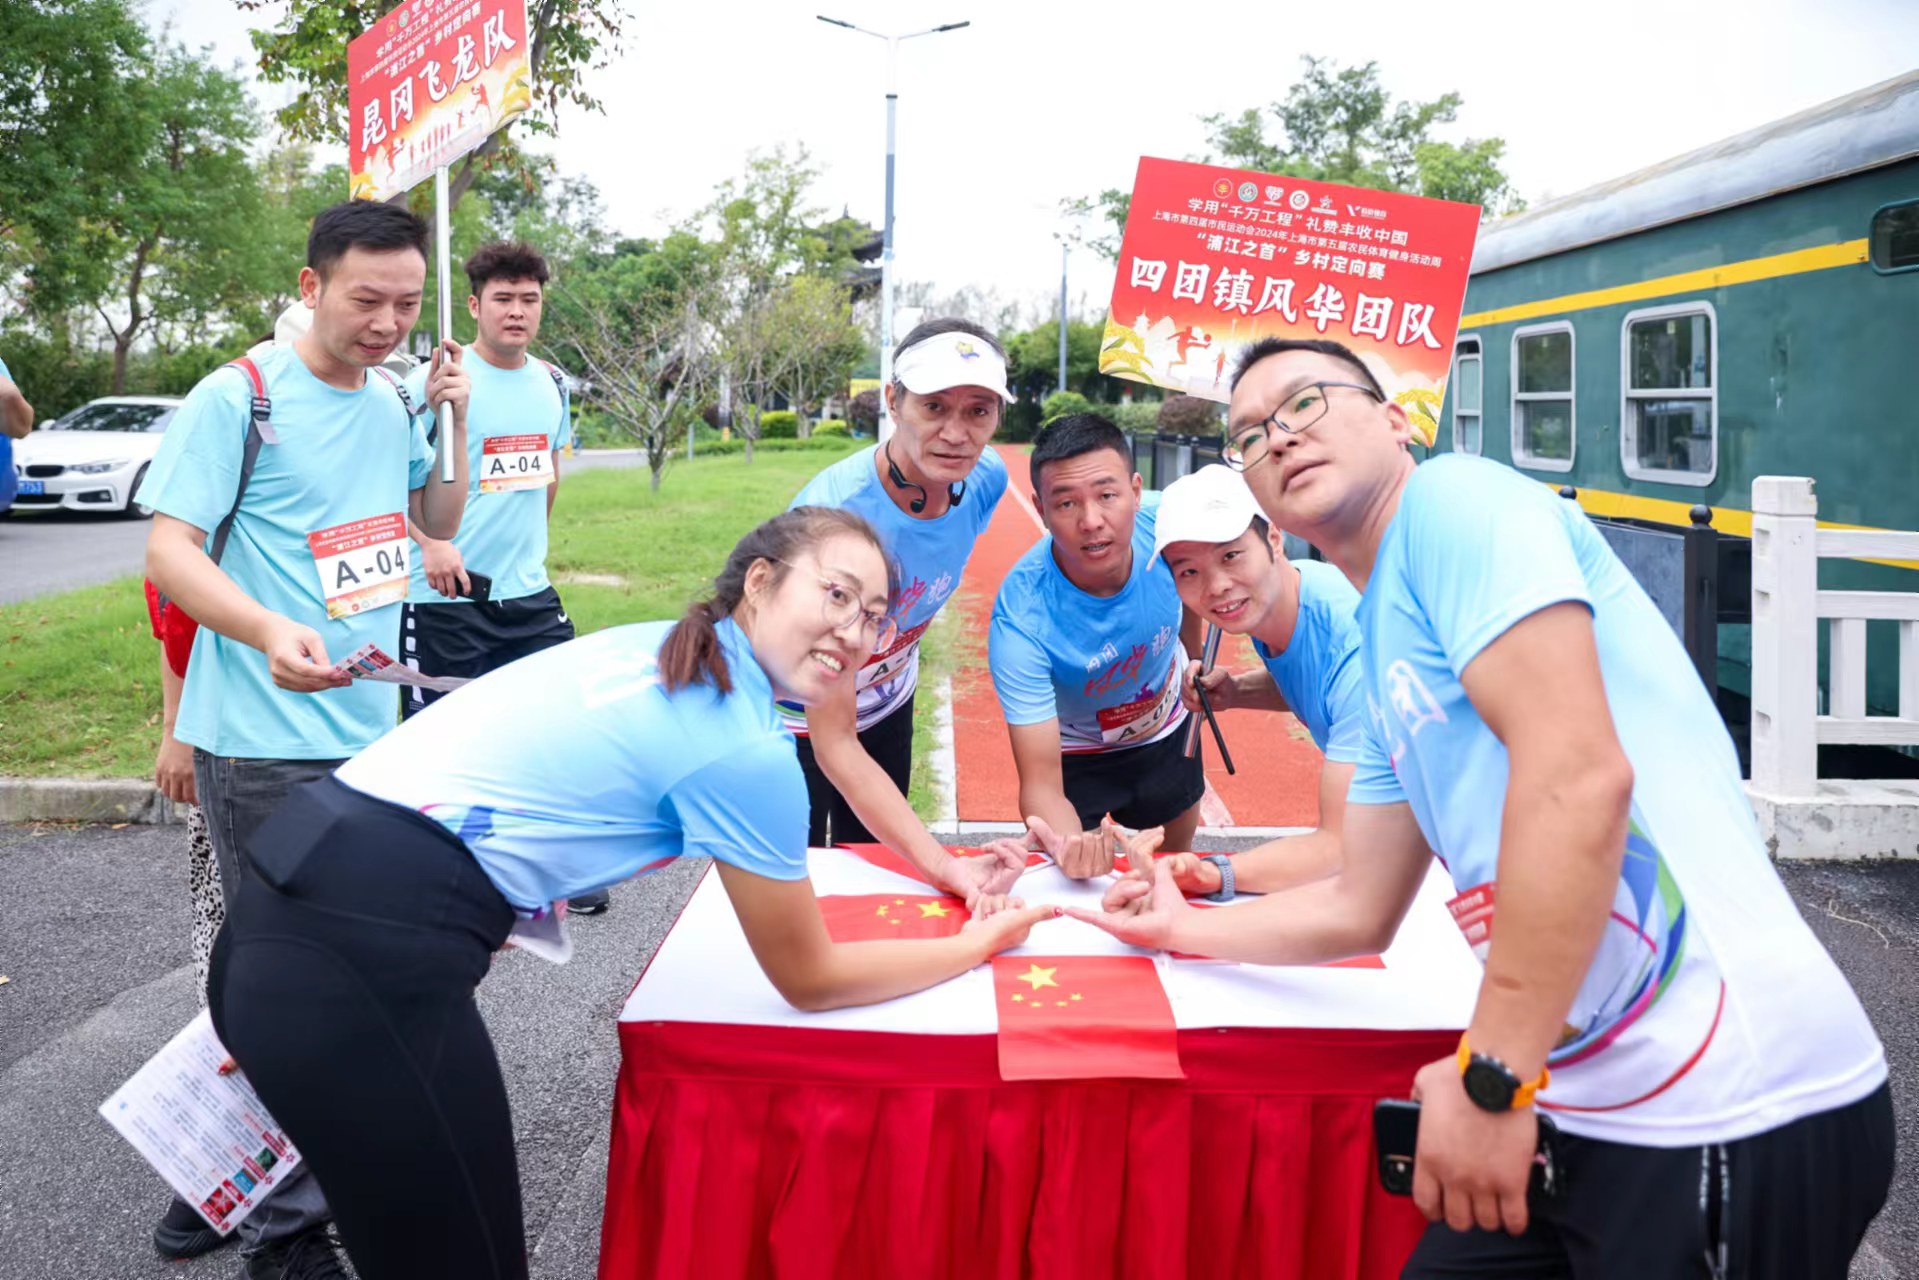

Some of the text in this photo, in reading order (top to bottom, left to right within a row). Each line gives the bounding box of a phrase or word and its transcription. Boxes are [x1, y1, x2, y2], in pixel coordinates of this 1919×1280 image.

[361, 9, 516, 153] 昆冈飞龙队
[1130, 256, 1443, 350] 四团镇风华团队
[490, 455, 541, 475] A-04
[336, 545, 405, 589] A-04
